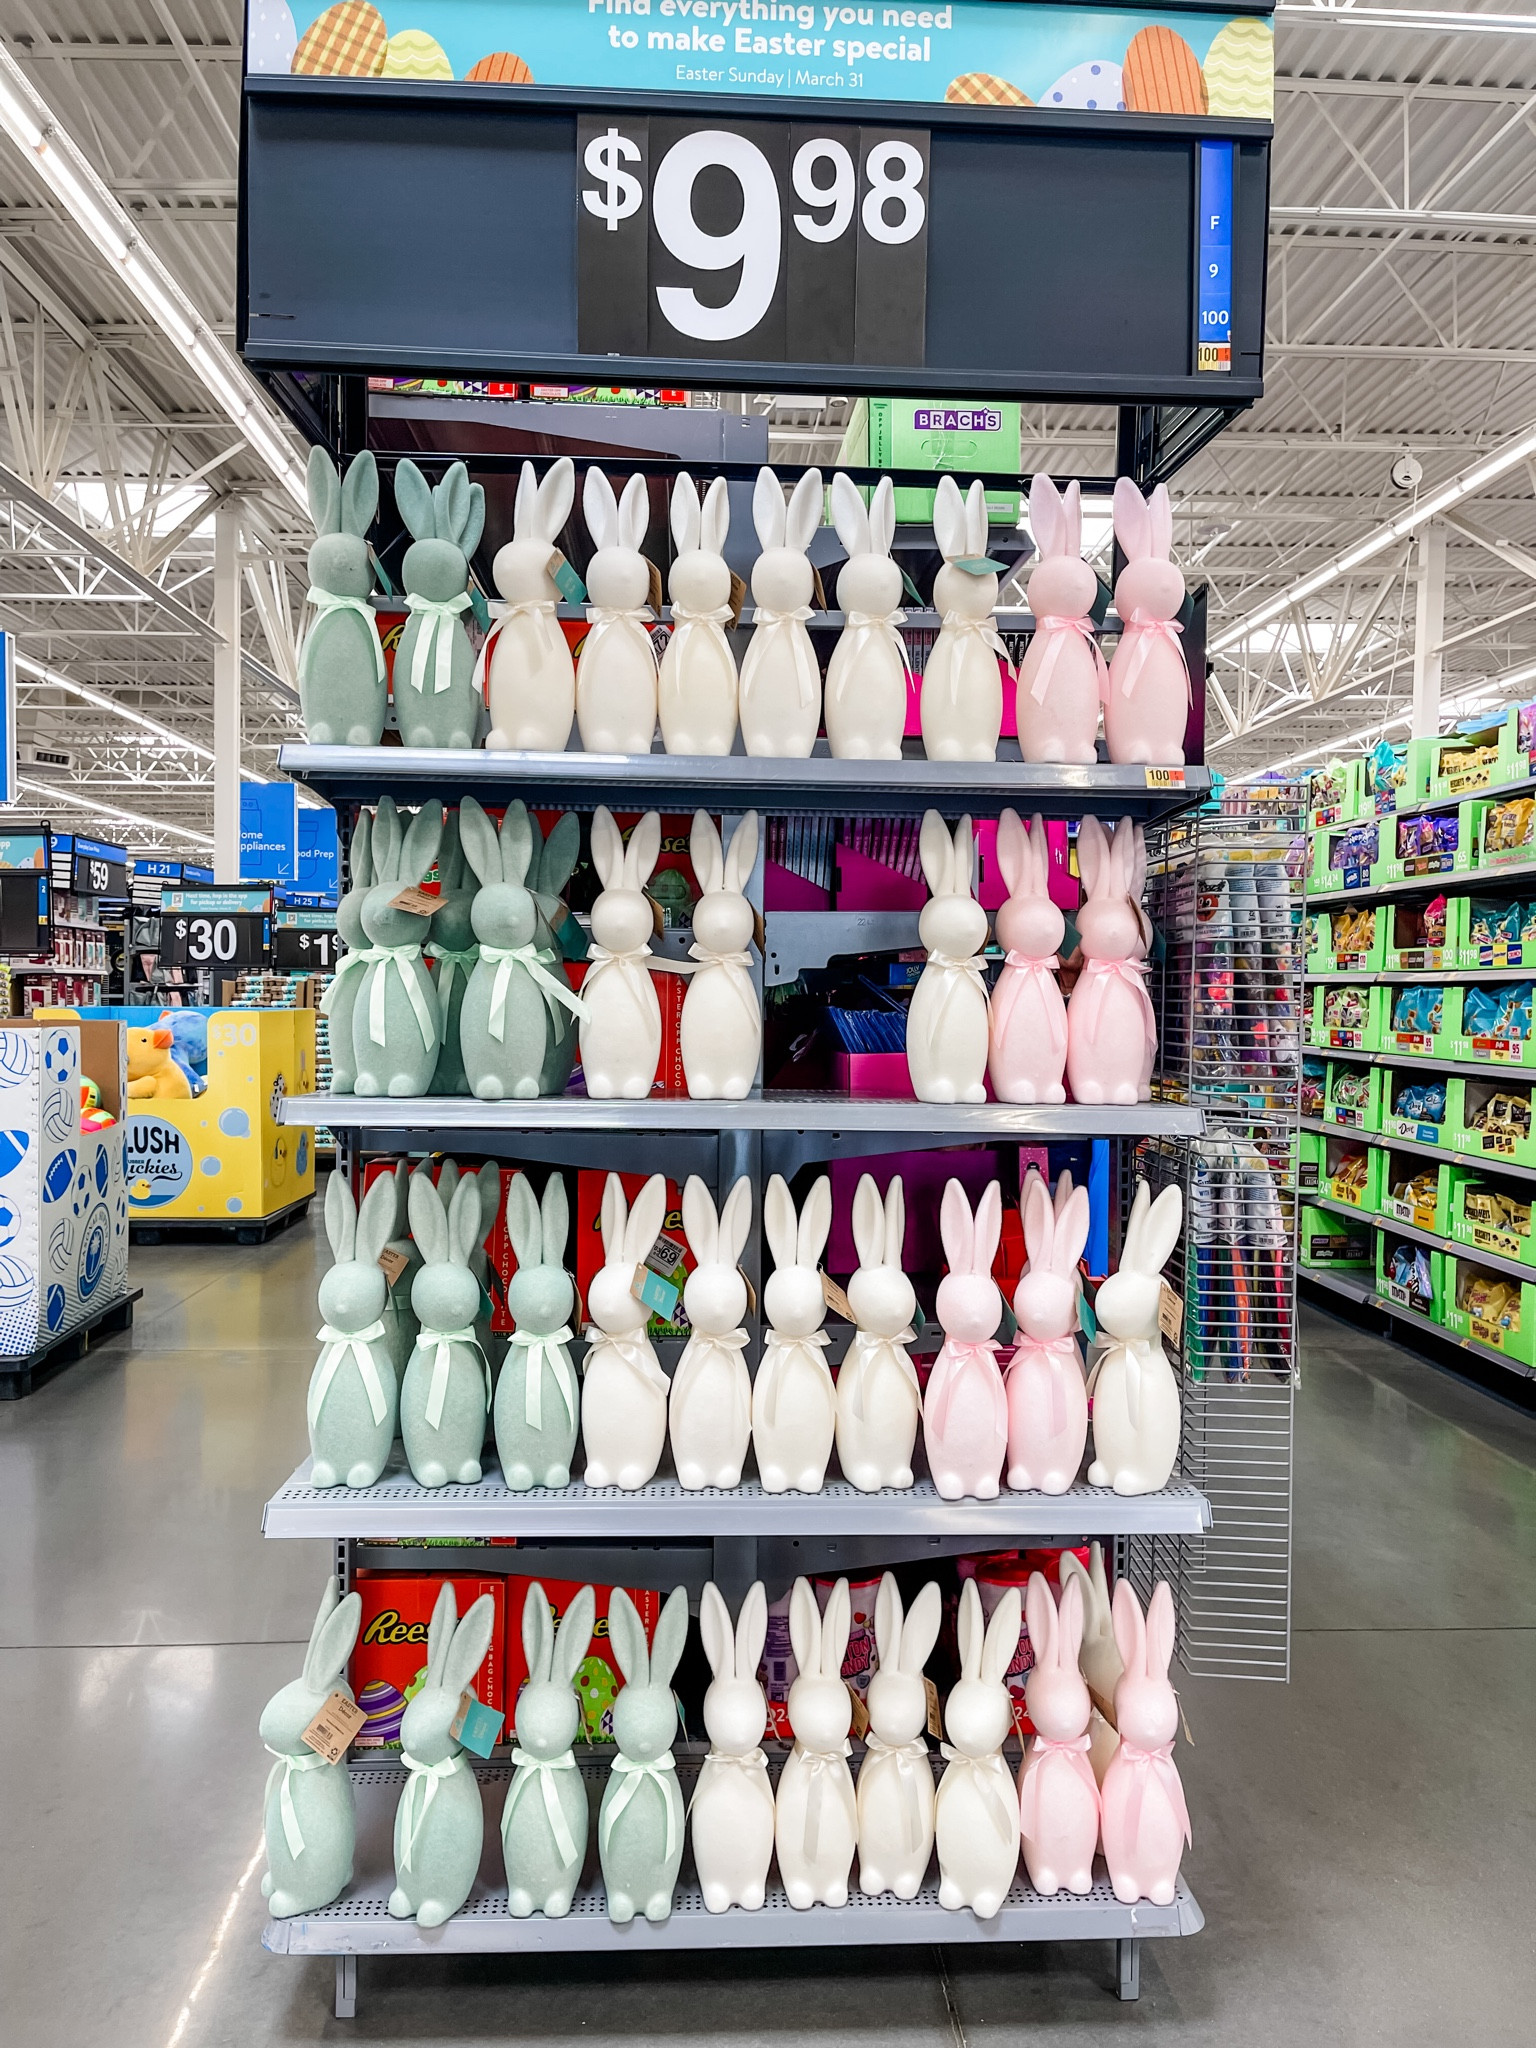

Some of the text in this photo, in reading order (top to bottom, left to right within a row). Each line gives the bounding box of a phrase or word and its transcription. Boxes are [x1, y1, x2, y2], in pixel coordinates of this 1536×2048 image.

[659, 0, 814, 29] everything
[823, 7, 874, 31] you
[882, 6, 953, 29] need
[608, 24, 931, 65] to make Easter special
[676, 65, 725, 82] Easter
[729, 67, 785, 87] Sunday
[795, 71, 844, 87] March
[848, 73, 864, 87] 31
[1210, 216, 1220, 230] F
[1209, 263, 1219, 278] 9
[1202, 310, 1229, 325] 100
[1199, 347, 1219, 362] 100
[1149, 769, 1170, 781] 100
[240, 841, 286, 853] ppliances
[297, 850, 334, 860] ood Prep
[90, 860, 109, 891] $59
[148, 864, 170, 874] H 21
[294, 897, 312, 905] H 25
[175, 919, 237, 960] $30
[1442, 949, 1453, 960] 100
[906, 964, 920, 974] JOLLY
[213, 1023, 257, 1047] $30
[1425, 1037, 1432, 1047] 95
[1512, 1043, 1520, 1054] 95
[1398, 1123, 1415, 1135] Dove
[660, 1245, 679, 1263] 69
[341, 1698, 358, 1715] EASTER
